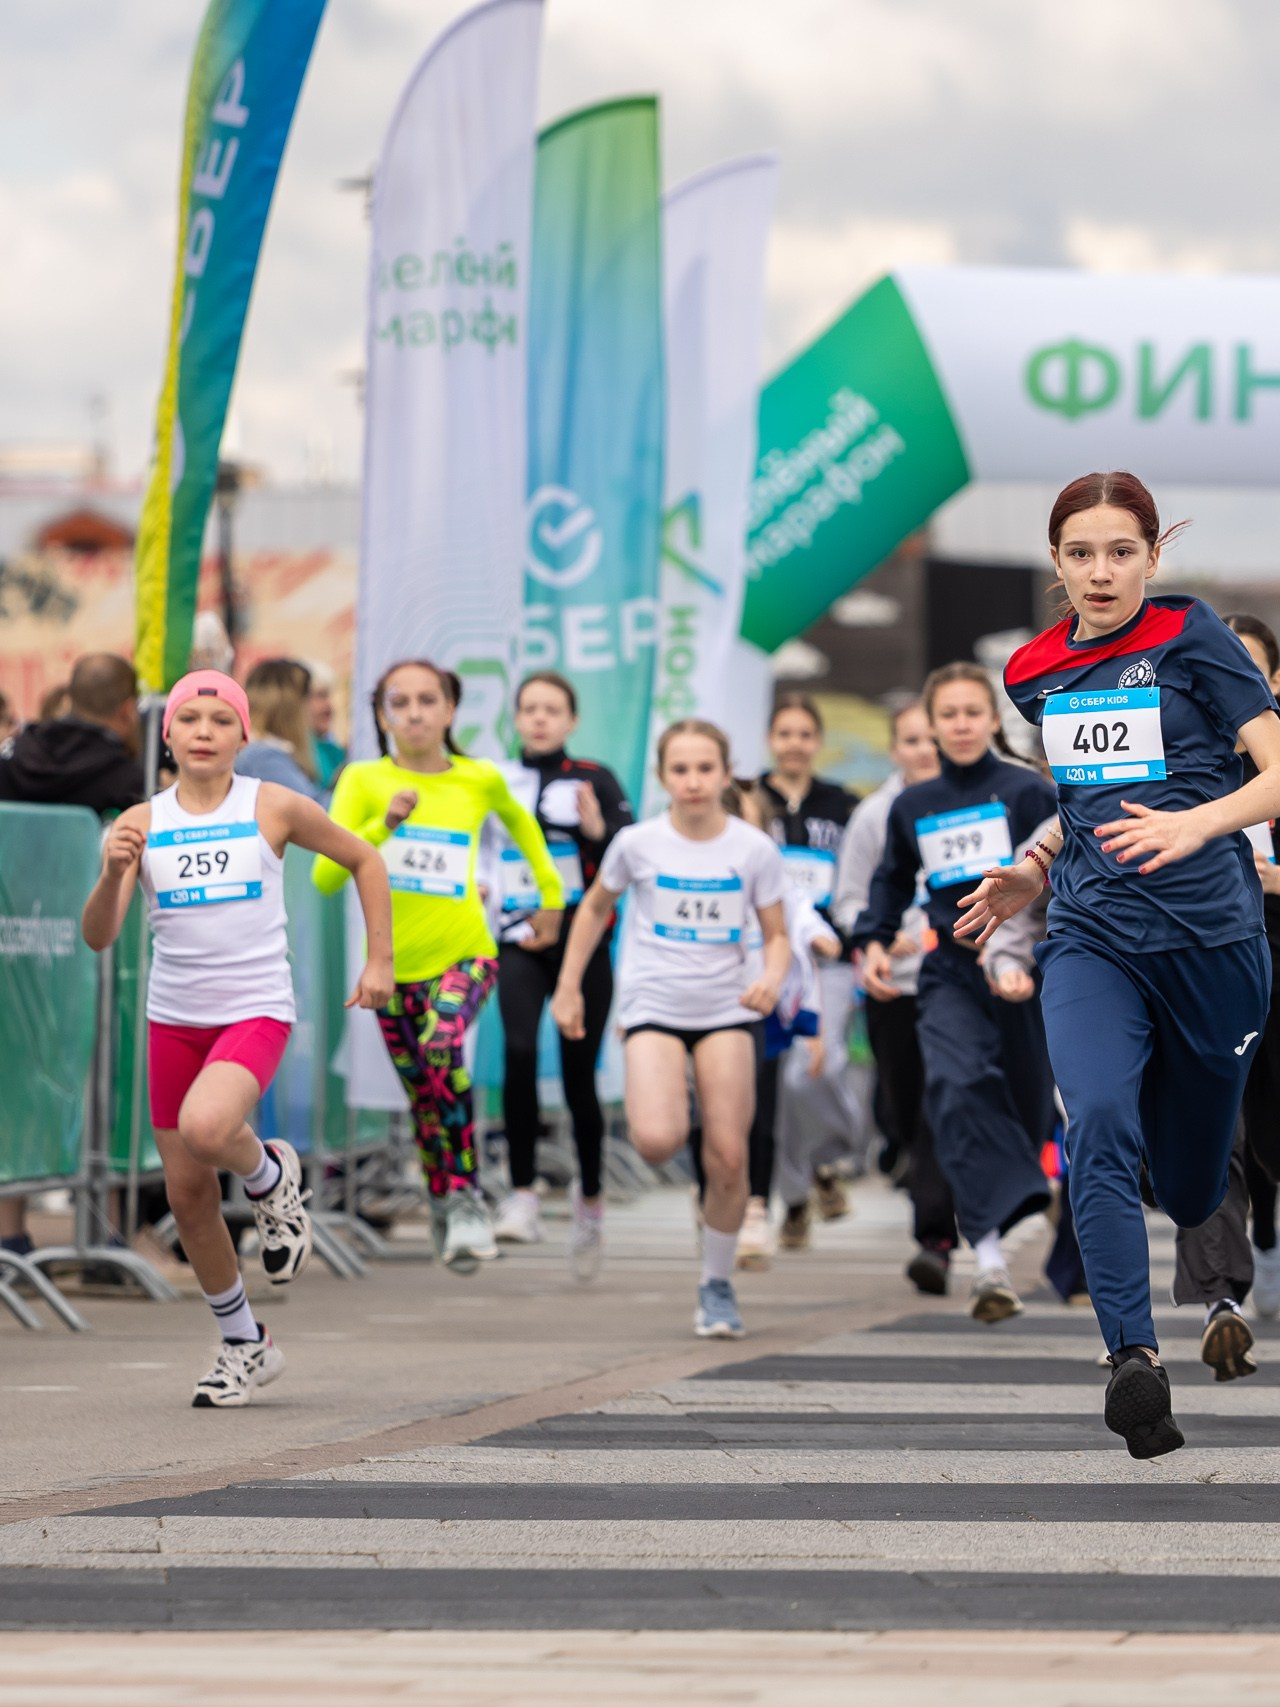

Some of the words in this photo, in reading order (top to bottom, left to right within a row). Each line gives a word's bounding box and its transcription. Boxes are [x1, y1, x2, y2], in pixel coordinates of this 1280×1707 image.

[178, 57, 250, 346] БЕР
[519, 597, 660, 672] БЕР
[1081, 697, 1106, 707] СБЕР
[1107, 695, 1129, 705] KIDS
[1073, 721, 1130, 754] 402
[1066, 768, 1086, 781] 420
[941, 830, 983, 860] 299
[178, 850, 229, 879] 259
[403, 847, 448, 874] 426
[675, 899, 721, 921] 414
